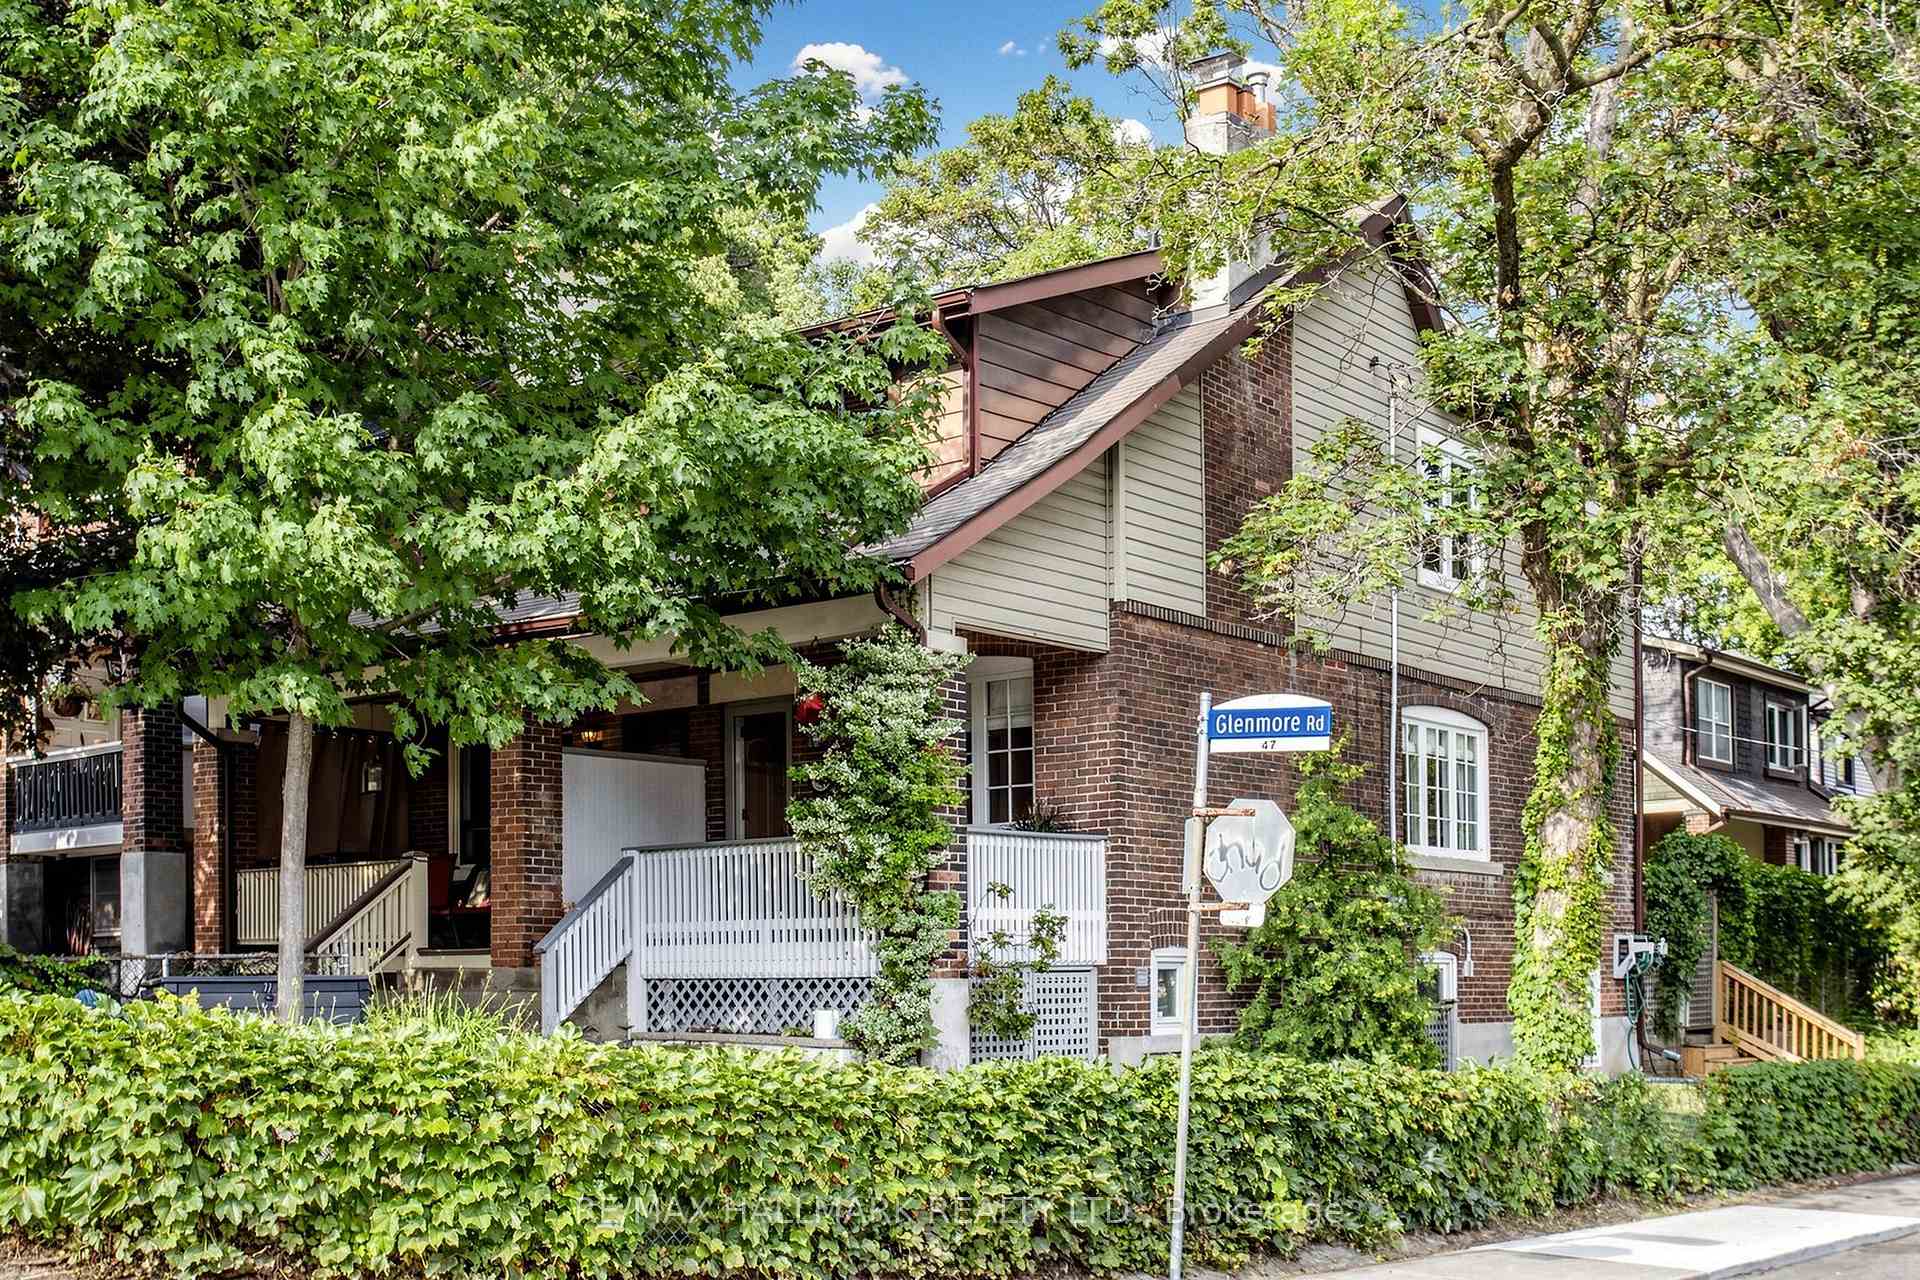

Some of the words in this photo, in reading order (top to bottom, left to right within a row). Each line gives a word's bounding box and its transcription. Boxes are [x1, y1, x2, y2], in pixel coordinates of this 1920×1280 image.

[1215, 714, 1301, 734] Glenmore
[1306, 714, 1325, 732] Rd
[1262, 740, 1276, 750] 47
